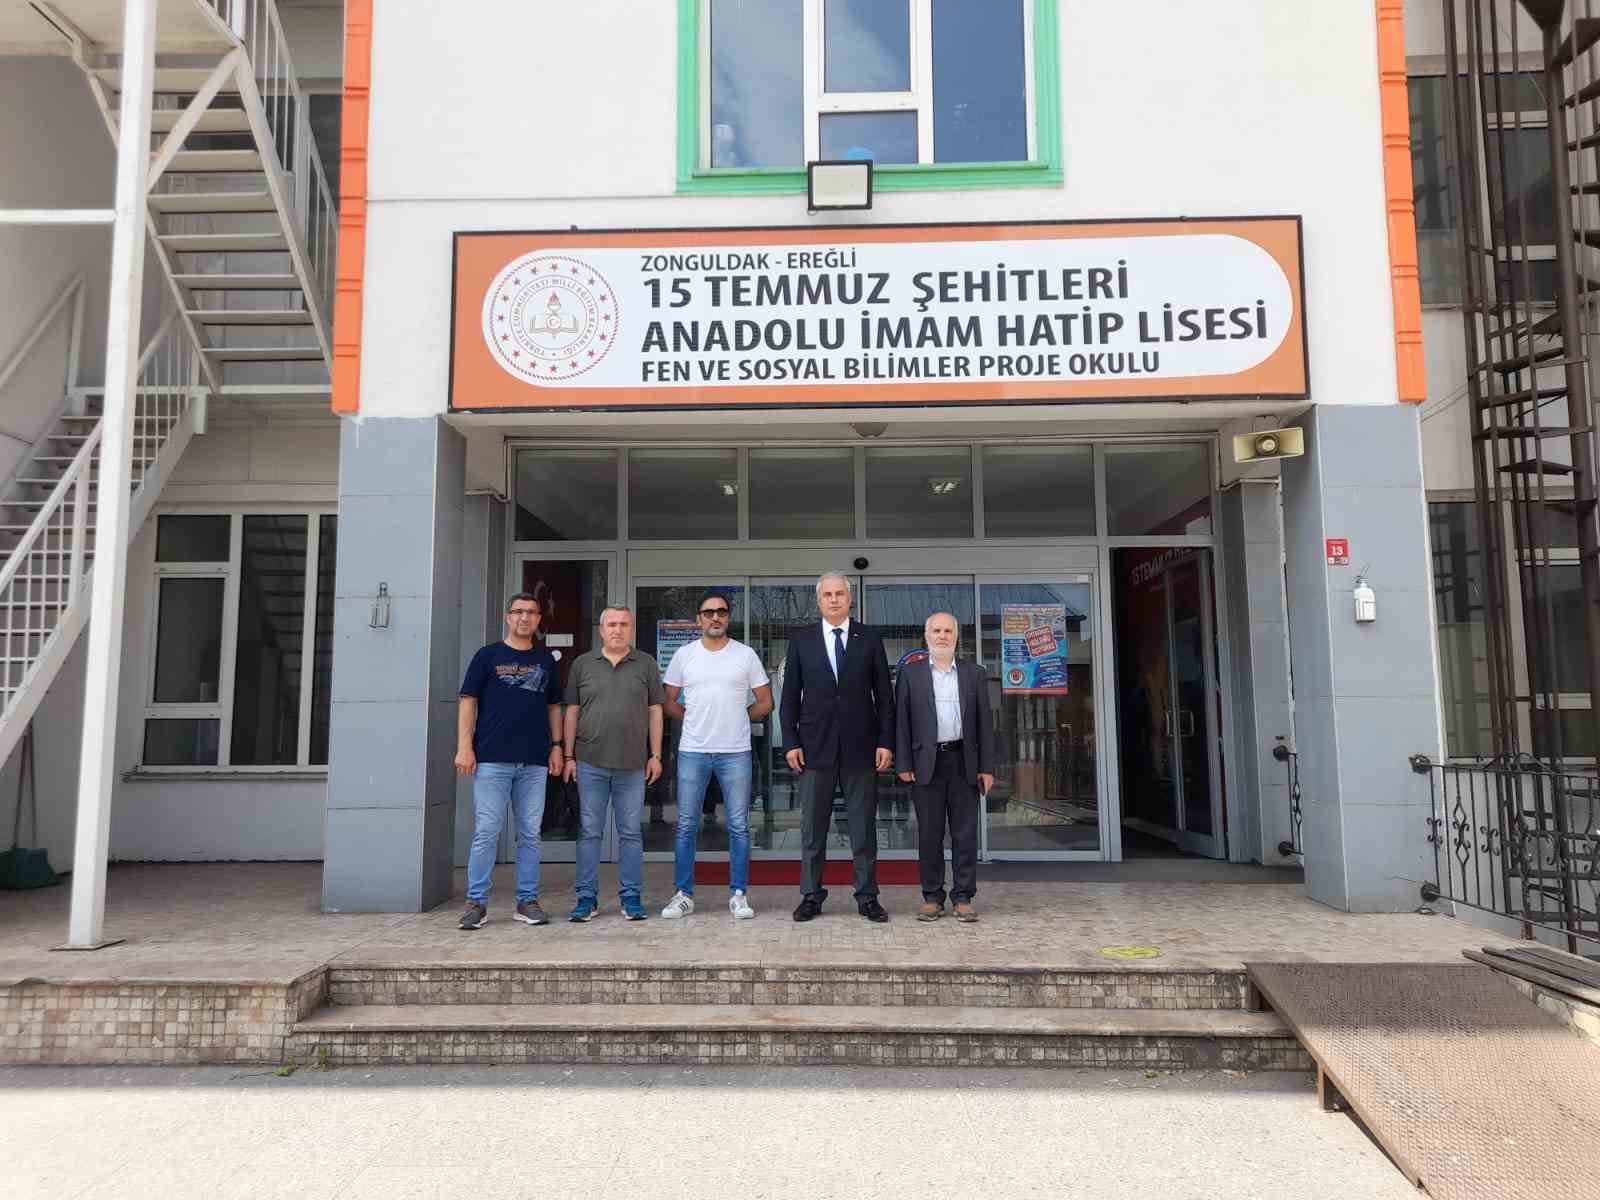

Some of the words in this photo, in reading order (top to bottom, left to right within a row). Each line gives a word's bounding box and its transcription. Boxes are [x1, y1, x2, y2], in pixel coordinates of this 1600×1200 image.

[641, 253, 769, 272] ZONGULDAK
[787, 247, 856, 269] EREĞLİ
[643, 277, 692, 308] 15
[704, 273, 890, 307] TEMMUZ
[912, 259, 1129, 313] ŞEHİTLERİ
[641, 318, 845, 353] ANADOLU
[861, 310, 983, 350] İMAM
[997, 305, 1124, 347] HATİP
[1138, 299, 1267, 343] LİSESİ
[642, 360, 690, 382] FEN
[698, 359, 731, 381] VE
[738, 358, 836, 381] SOSYAL
[844, 352, 971, 379] BİLİMLER
[979, 354, 1061, 377] PROJE
[1068, 352, 1160, 375] OKULU
